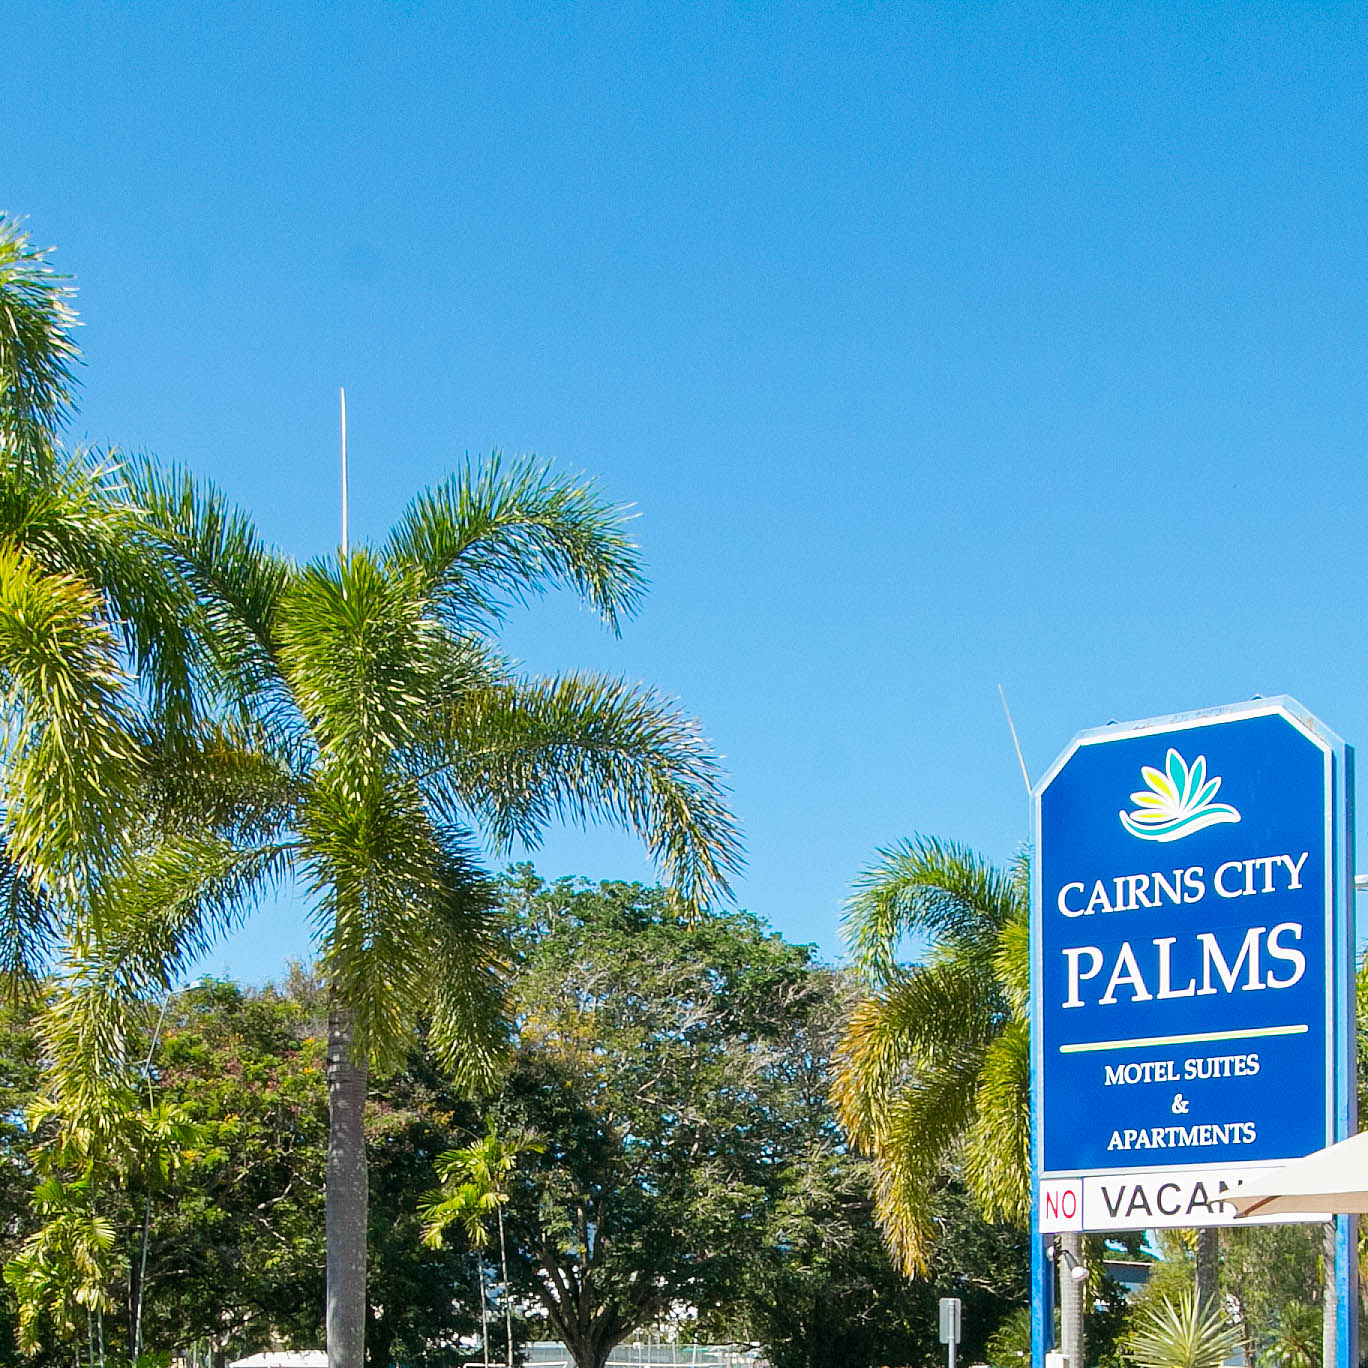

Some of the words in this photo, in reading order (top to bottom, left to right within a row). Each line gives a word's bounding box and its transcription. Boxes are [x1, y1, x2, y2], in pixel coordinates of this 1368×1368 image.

[1057, 866, 1206, 918] CAIRNS
[1213, 851, 1309, 899] CITY
[1061, 922, 1307, 1009] PALMS
[1104, 1060, 1181, 1086] MOTEL
[1184, 1053, 1261, 1081] SUITES
[1171, 1093, 1190, 1114] &
[1107, 1121, 1257, 1151] APARTMENTS
[1046, 1189, 1077, 1220] NO
